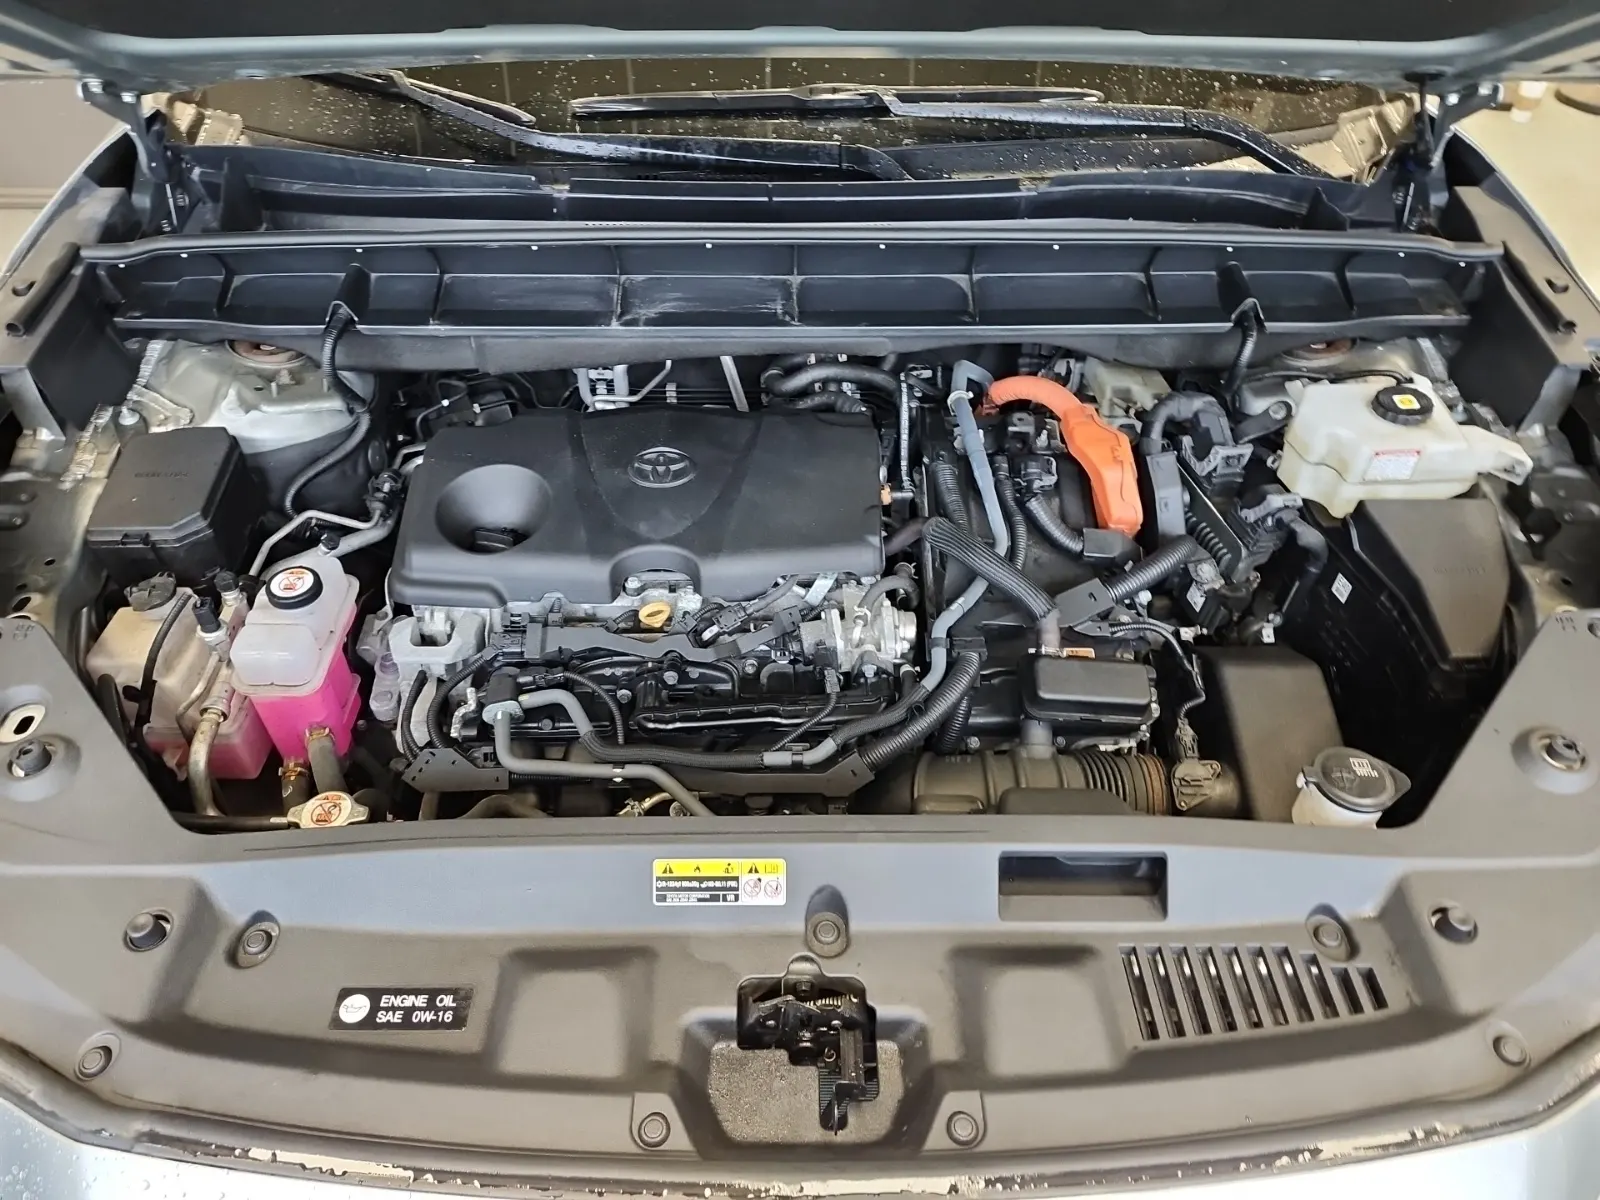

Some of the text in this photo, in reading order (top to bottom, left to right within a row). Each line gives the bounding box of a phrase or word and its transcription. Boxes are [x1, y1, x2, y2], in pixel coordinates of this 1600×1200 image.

[380, 995, 457, 1007] ENGINE OIL
[375, 1010, 453, 1023] SAE 0W-16
